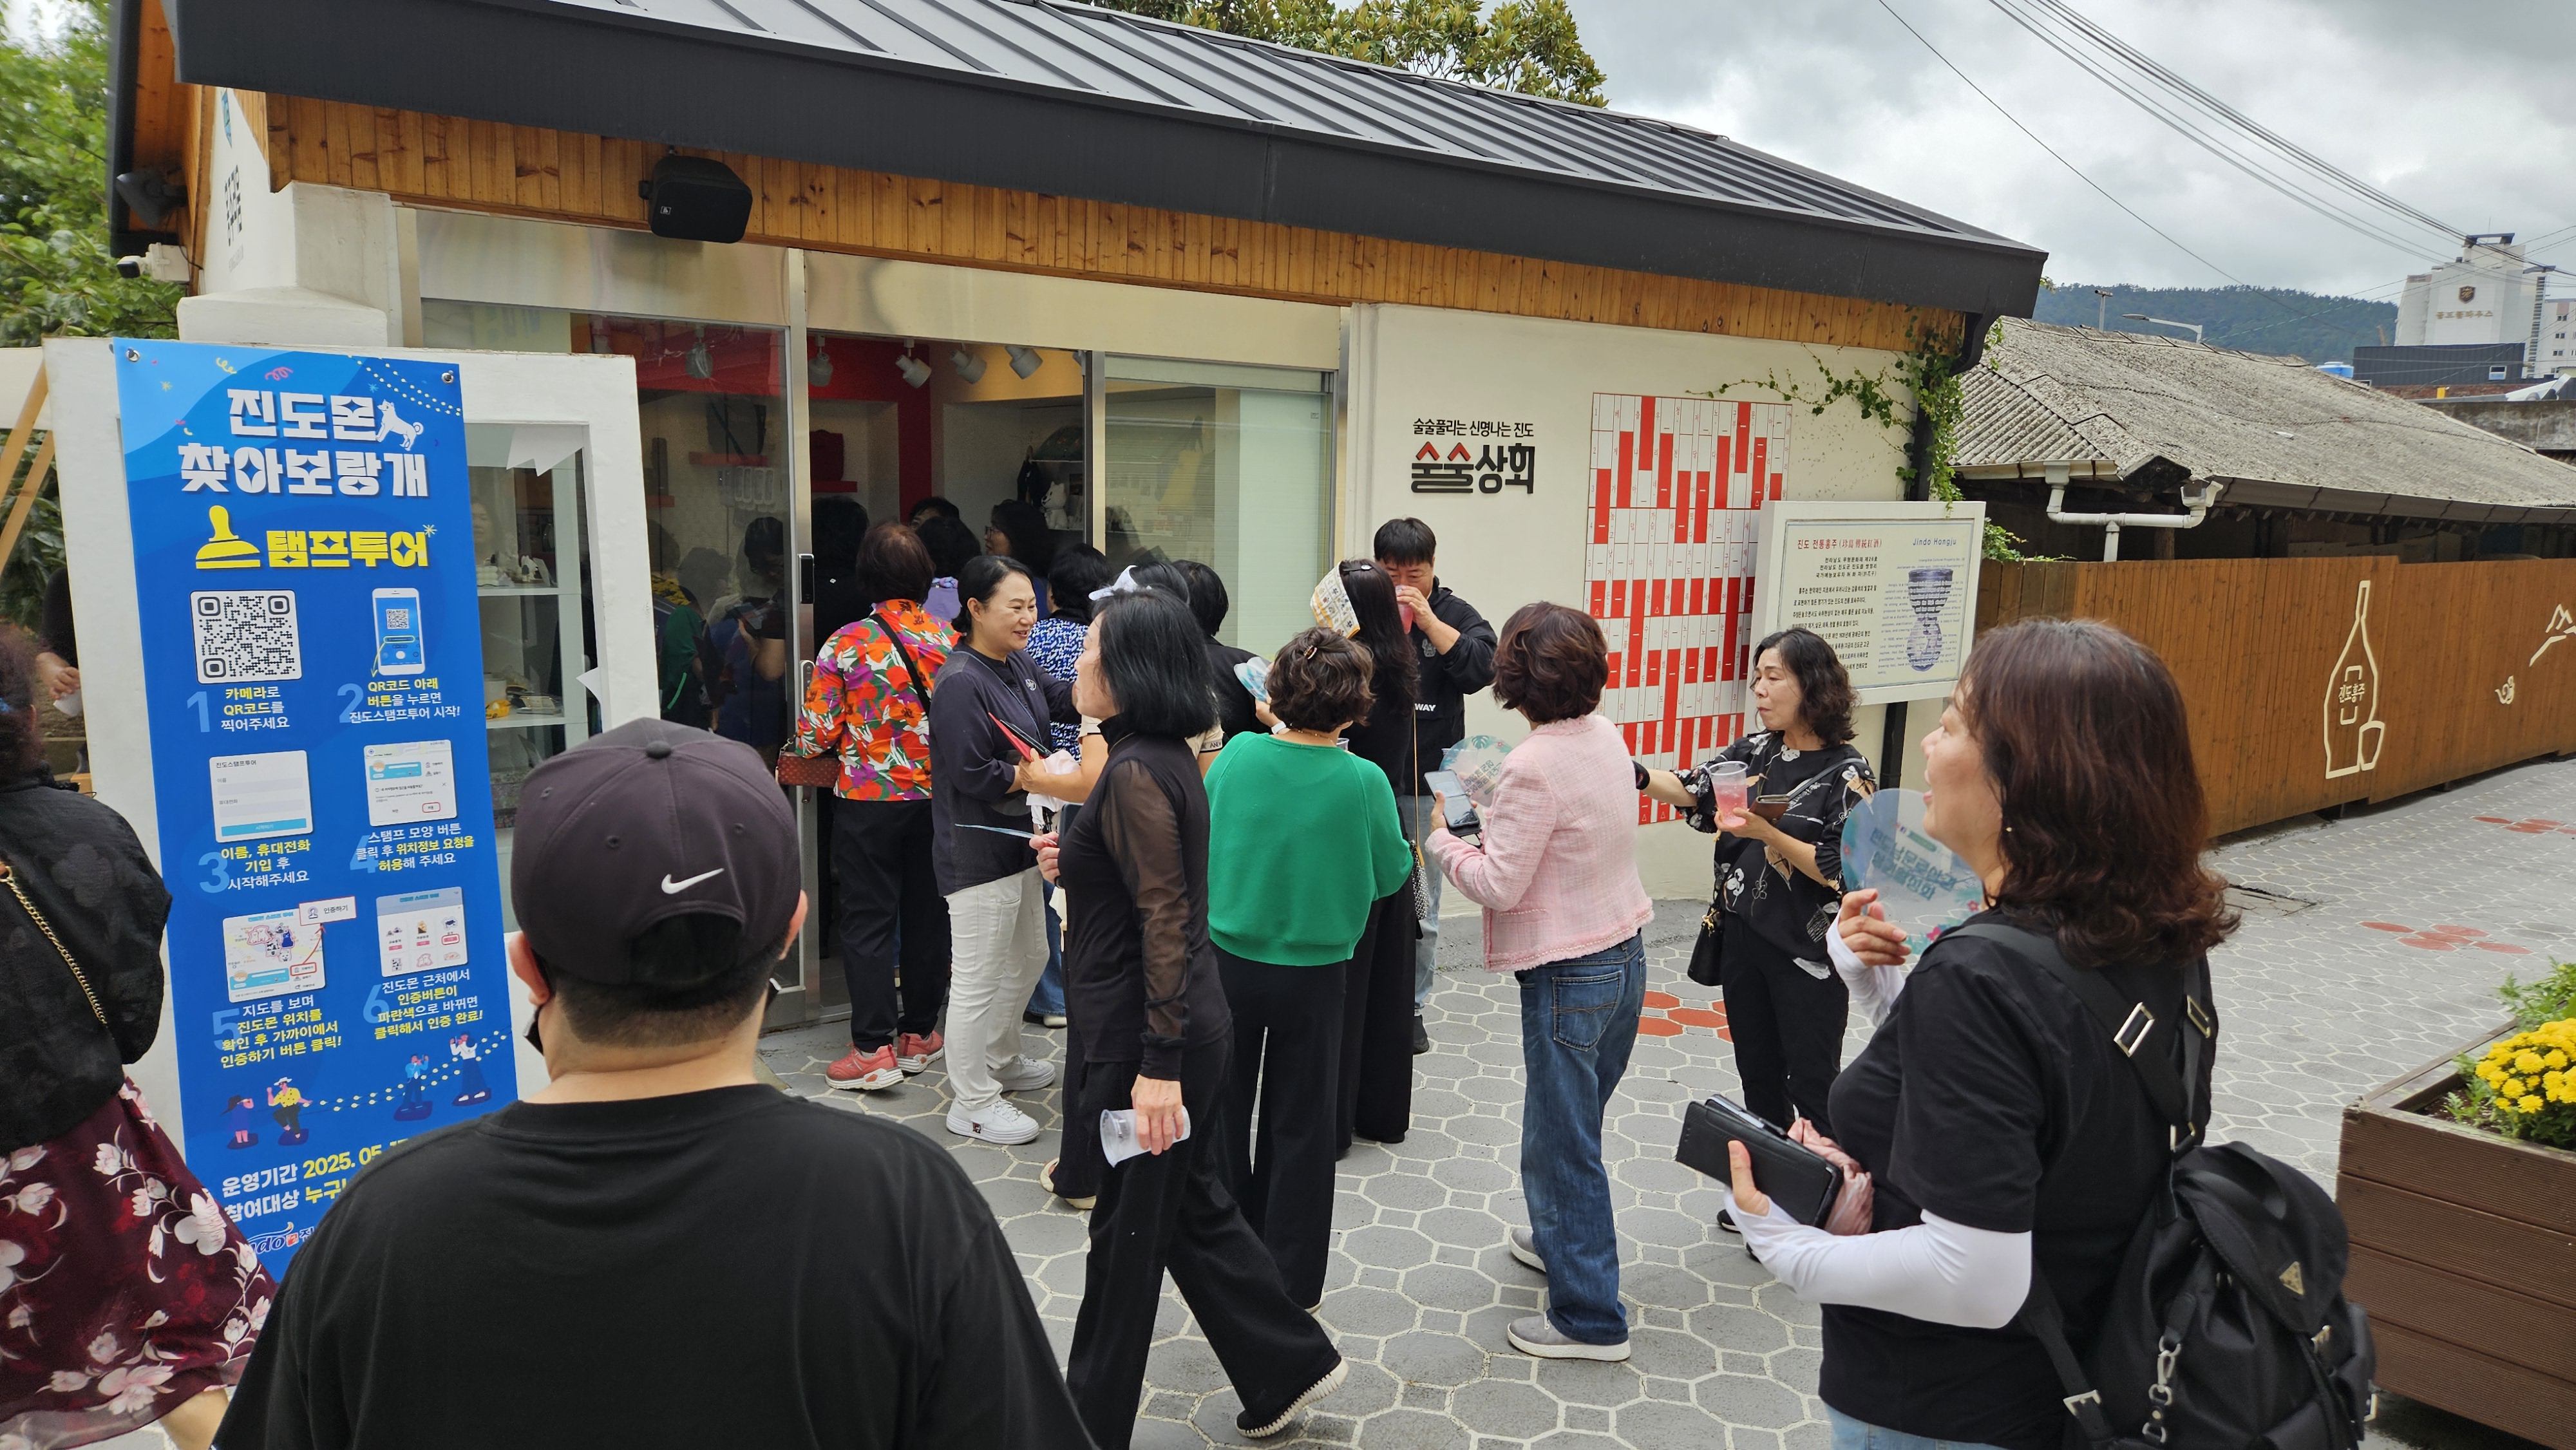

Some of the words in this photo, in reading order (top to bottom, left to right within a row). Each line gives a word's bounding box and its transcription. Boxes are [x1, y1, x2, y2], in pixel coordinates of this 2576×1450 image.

[1413, 419, 1467, 436] 술술풀리는
[1470, 421, 1511, 437] 신명나는
[1514, 422, 1534, 437] 진도
[178, 443, 428, 497] 찾아보랑개
[1411, 442, 1535, 494] 술술상회
[1797, 540, 1809, 549] 진도
[1813, 539, 1837, 549] 전통홍주
[1934, 538, 1956, 546] Hongju
[225, 687, 280, 701] 카메라로
[368, 679, 410, 692] QR코드
[415, 678, 439, 690] 아래
[2338, 683, 2365, 703] 진도홍주
[223, 702, 284, 716] QR코드를
[367, 695, 404, 707] 버튼을
[408, 692, 441, 705] 누르면
[187, 692, 210, 732] 1
[350, 708, 430, 724] 진도스탬프투어
[434, 706, 460, 719] 시작!
[221, 717, 289, 731] 찍어주세요
[216, 760, 256, 768] 진도스탬프투어
[368, 828, 405, 843] 스탬프
[410, 825, 433, 841] 모양
[438, 823, 462, 836] 버튼
[221, 845, 252, 861] 이름,
[257, 840, 310, 857] 휴대전화
[355, 847, 379, 860] 클릭
[383, 845, 393, 858] 후
[396, 841, 440, 856] 위치정보
[443, 835, 475, 850] 요청을
[245, 860, 272, 873] 기입
[277, 857, 290, 871] 후
[379, 856, 416, 872] 허용해
[420, 852, 456, 867] 주세요
[227, 870, 309, 891] 시작해주세요
[324, 905, 348, 914] 인증하기
[383, 978, 419, 995] 진도몬
[422, 969, 471, 988] 근처에서
[243, 999, 284, 1017] 지도를
[289, 995, 314, 1010] 보며
[397, 985, 457, 1006] 인증버튼이
[377, 1003, 439, 1022] 파란색으로
[442, 997, 478, 1012] 바뀌면
[237, 1017, 278, 1035] 진도몬
[283, 1010, 323, 1026] 위치를
[374, 1020, 424, 1040] 클릭해서
[428, 1016, 451, 1031] 인증
[455, 1010, 483, 1025] 완료!
[222, 1037, 251, 1053] 확인
[254, 1034, 269, 1048] 후
[273, 1020, 338, 1044] 가까이에서
[220, 1050, 275, 1069] 인증하기
[279, 1043, 306, 1057] 버튼
[311, 1036, 342, 1051] 클릭!
[222, 1164, 298, 1198] 운영기간
[303, 1151, 355, 1179] 2025.
[225, 1189, 299, 1223] 참여대상
